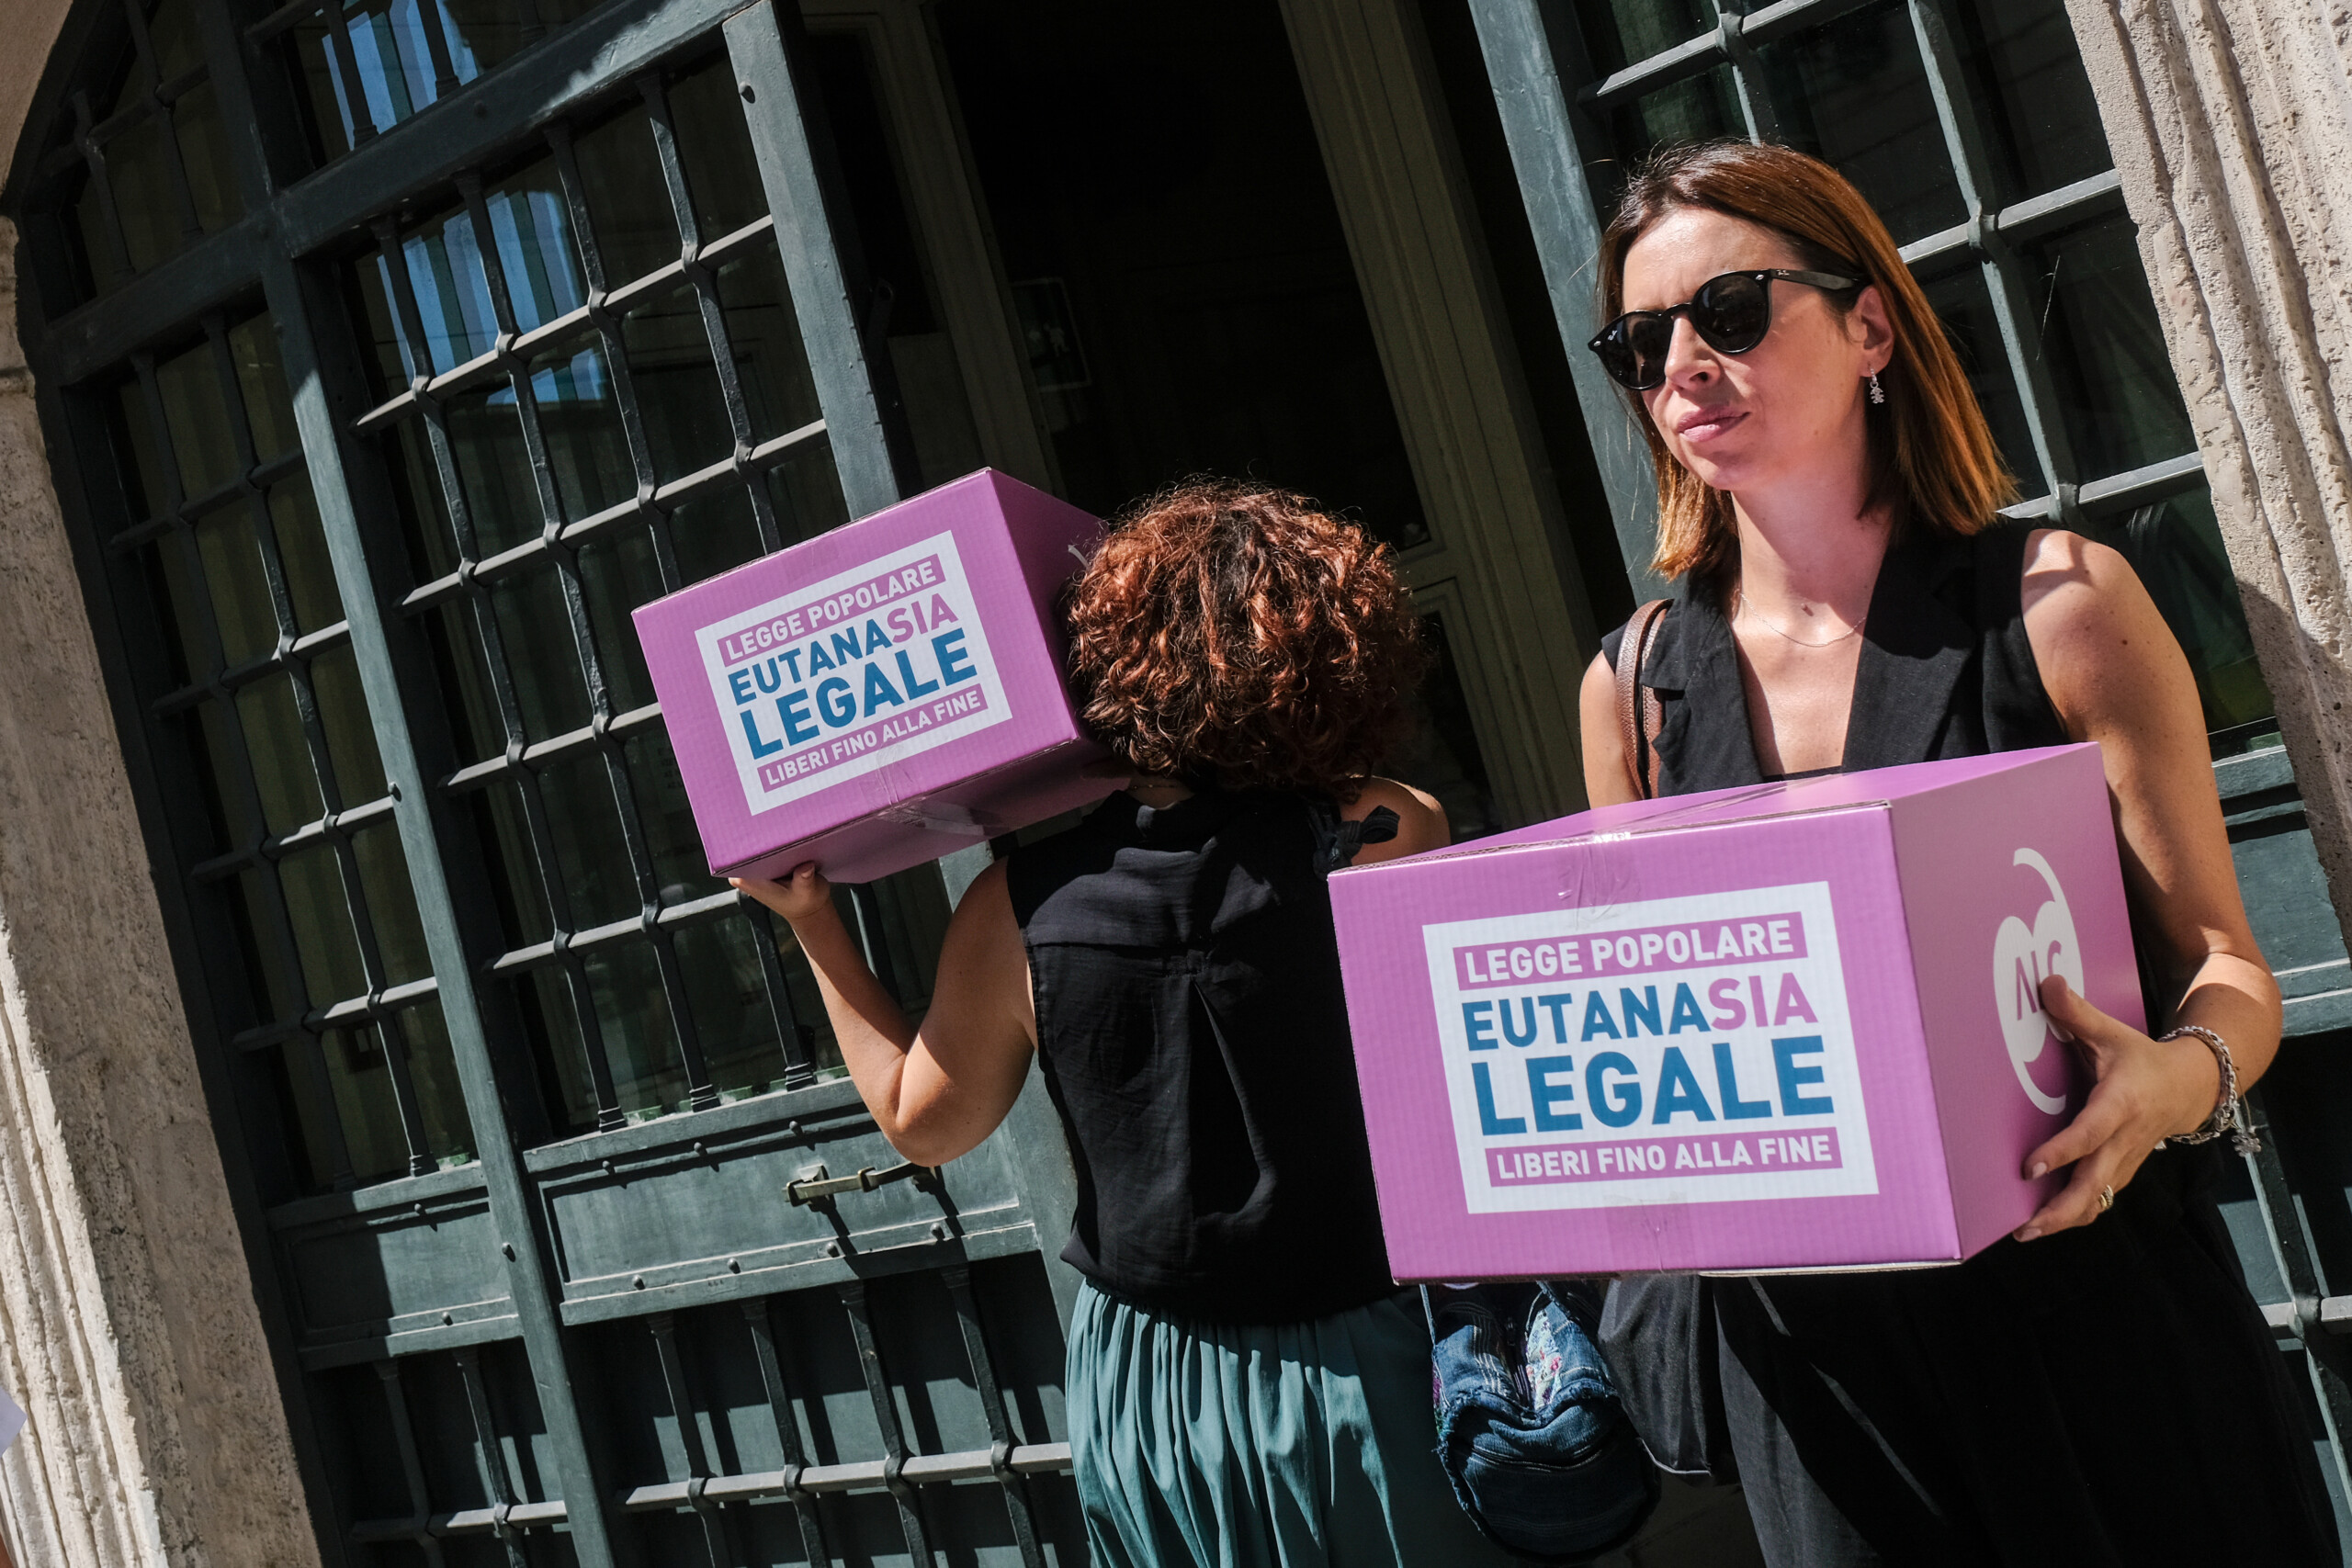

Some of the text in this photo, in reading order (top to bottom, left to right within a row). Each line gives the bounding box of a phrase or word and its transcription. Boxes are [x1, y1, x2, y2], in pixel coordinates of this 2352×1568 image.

[725, 560, 937, 660] LEGGE POPOLARE
[728, 592, 958, 706] EUTANASIA
[741, 627, 978, 760] LEGALE
[765, 690, 981, 785] LIBERI FINO ALLA FINE
[1465, 919, 1794, 984] LEGGE POPOLARE
[1462, 972, 1818, 1052] EUTANASIA
[1471, 1035, 1835, 1136] LEGALE
[1497, 1134, 1833, 1179] LIBERI FINO ALLA FINE
